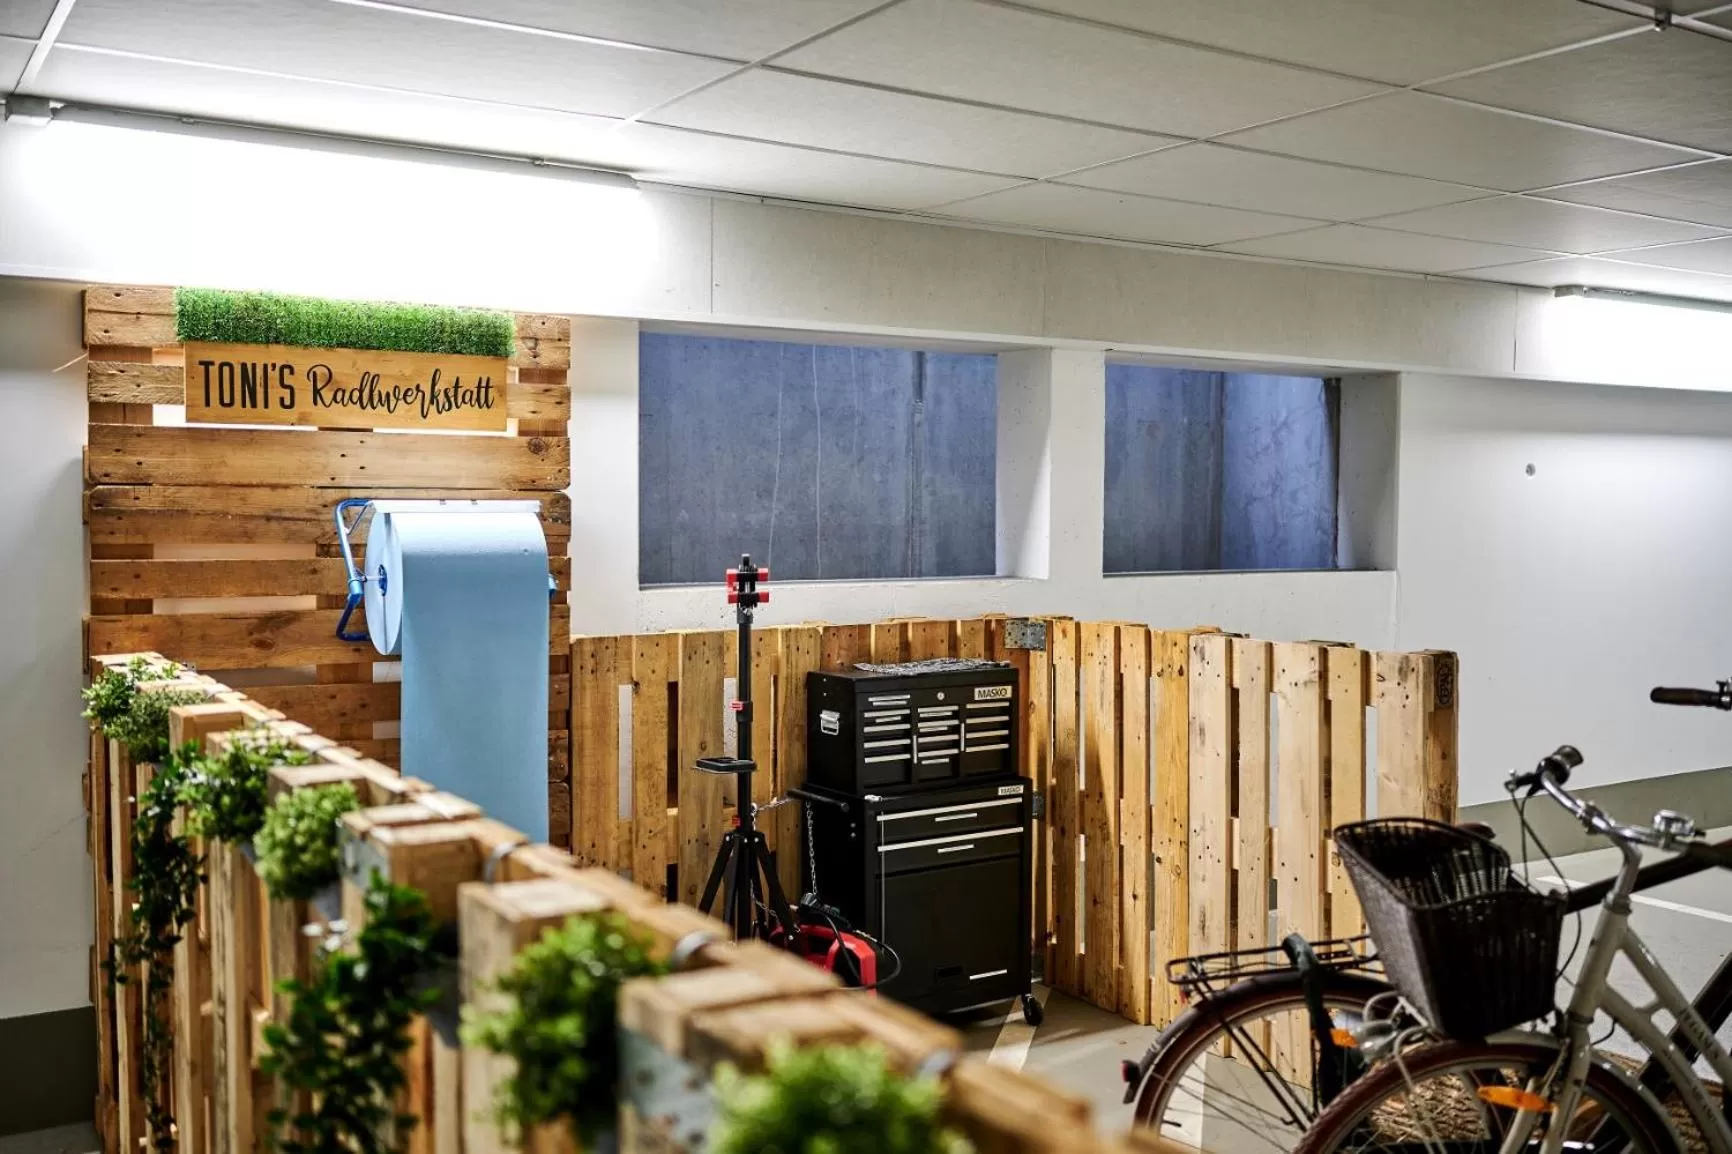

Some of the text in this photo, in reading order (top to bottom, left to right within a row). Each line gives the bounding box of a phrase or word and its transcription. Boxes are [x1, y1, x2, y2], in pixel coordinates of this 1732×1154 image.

[198, 360, 494, 419] TONI'S Radlwerkstatt
[977, 687, 1008, 699] MASKO
